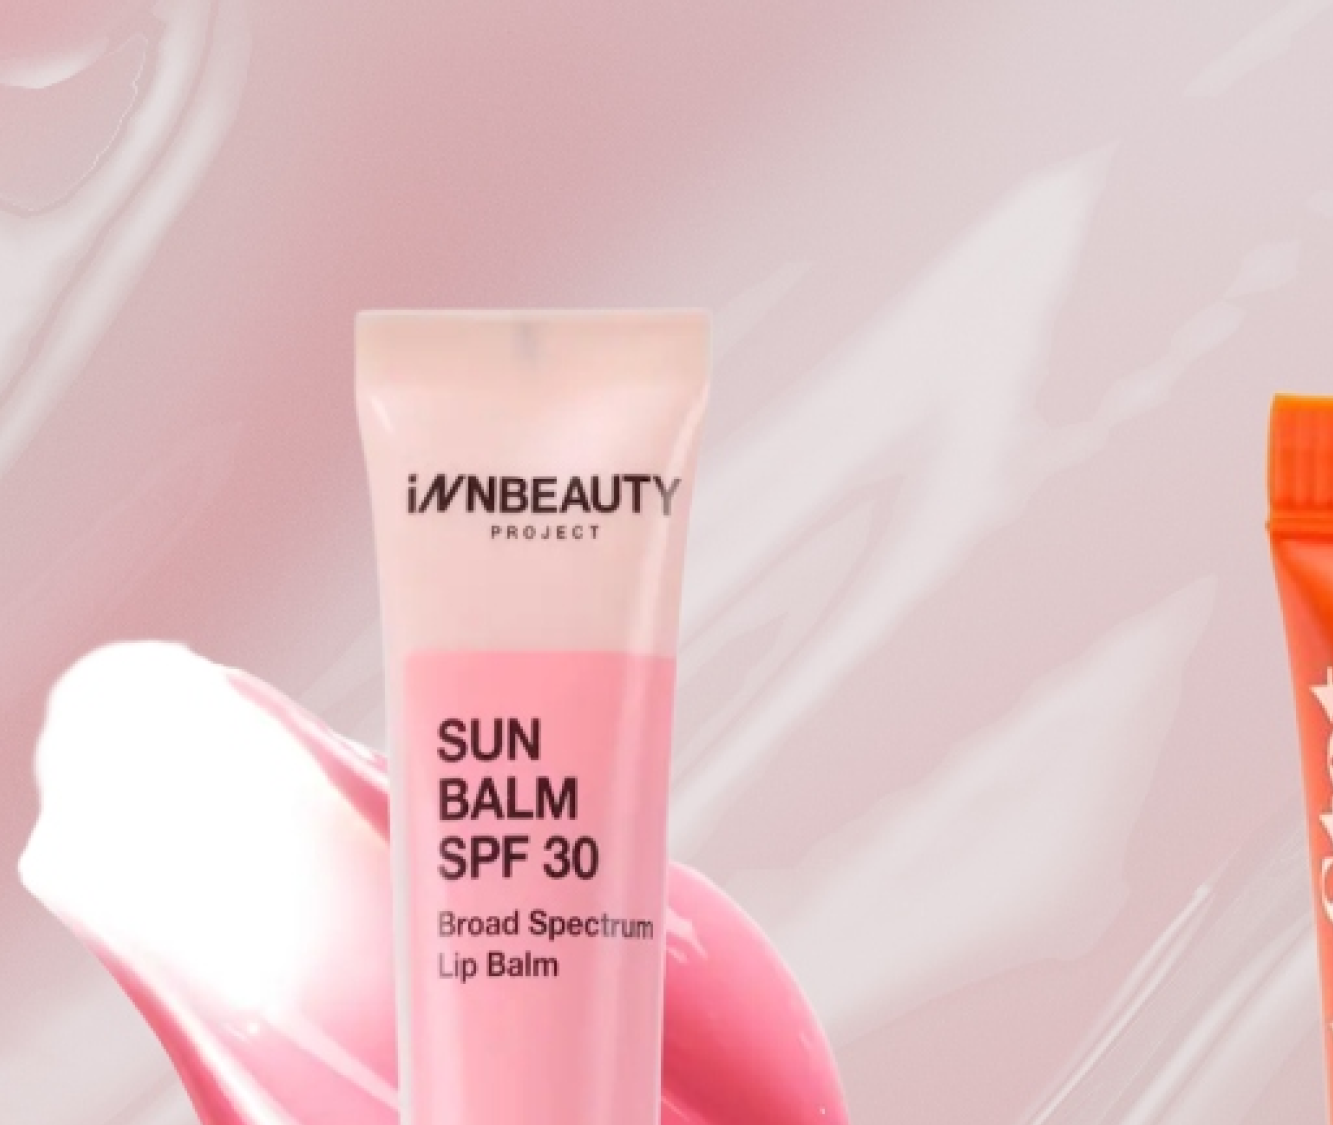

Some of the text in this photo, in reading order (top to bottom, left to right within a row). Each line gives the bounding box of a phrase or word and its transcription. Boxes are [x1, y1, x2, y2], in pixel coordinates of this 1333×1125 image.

[490, 525, 601, 541] PROJECT
[437, 717, 541, 763] SUN
[438, 776, 578, 821] BALM
[437, 835, 600, 880] SPF 30
[438, 909, 654, 941] Broad Spectrum
[438, 951, 559, 983] Lip Balm
